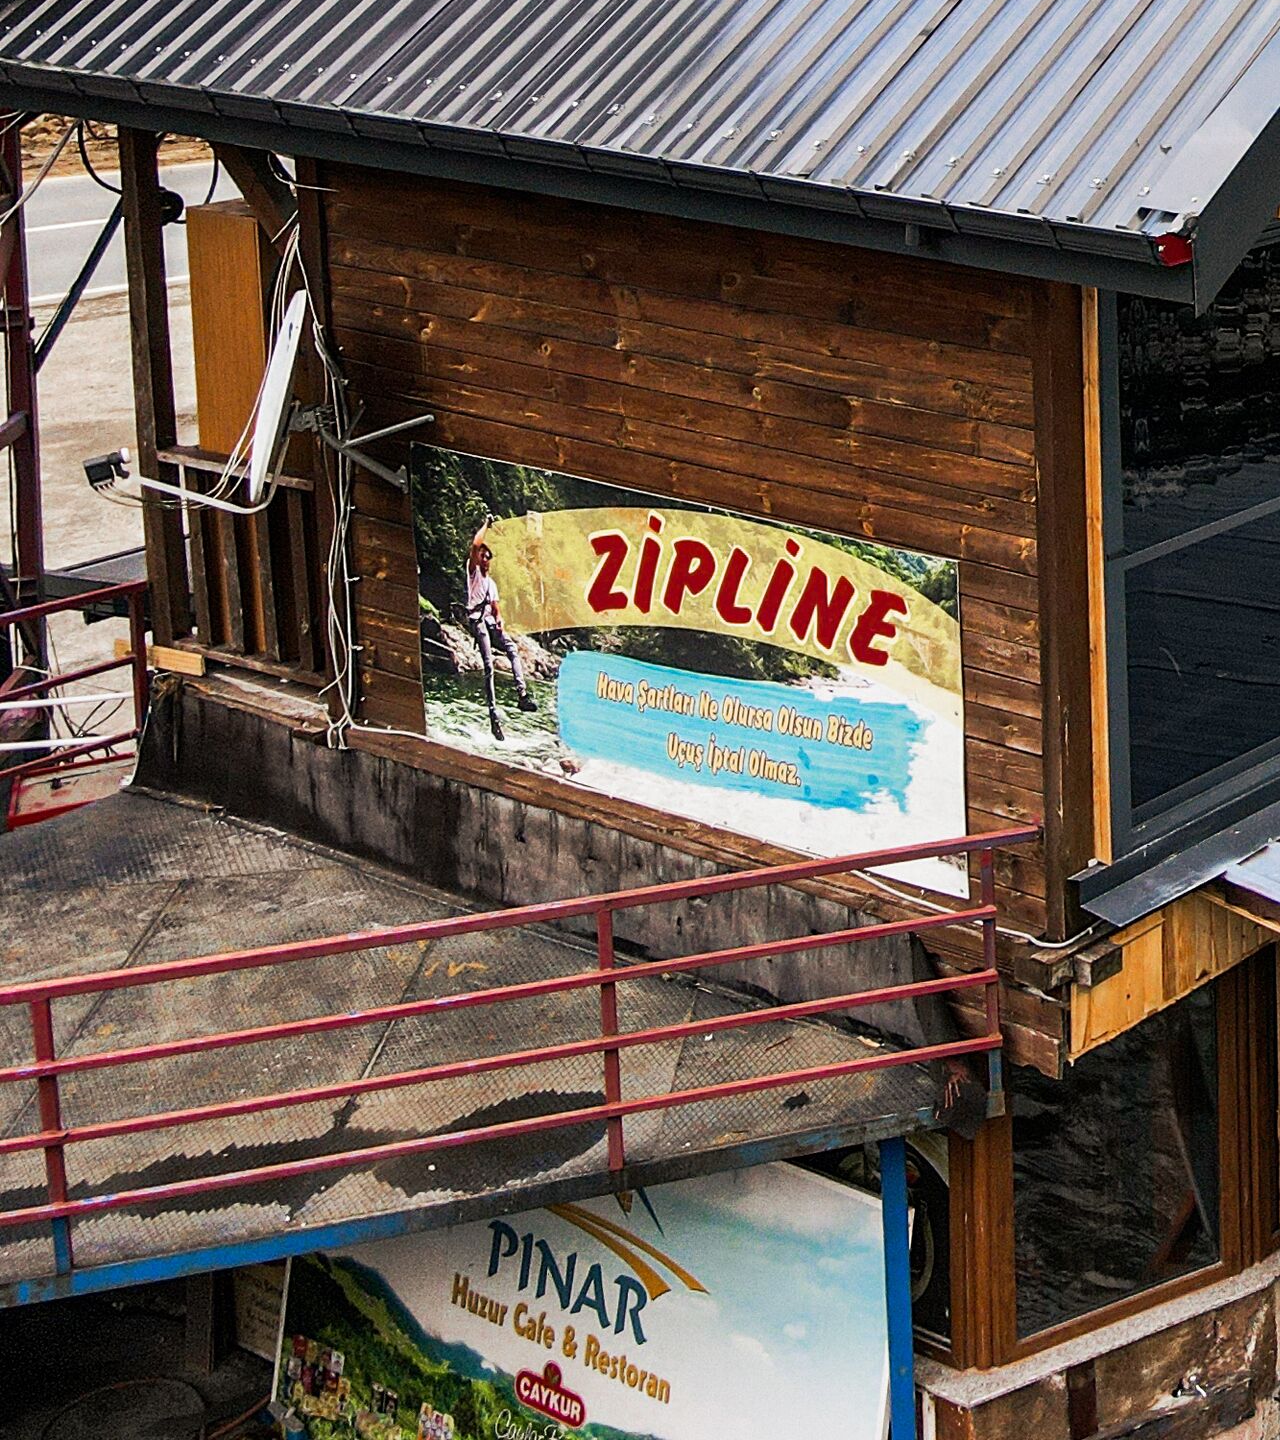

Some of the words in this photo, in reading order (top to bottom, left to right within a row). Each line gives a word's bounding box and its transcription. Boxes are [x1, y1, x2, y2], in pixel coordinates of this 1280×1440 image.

[597, 671, 635, 705] Hava
[638, 679, 695, 713] Şartları
[699, 690, 719, 721] Ne
[723, 695, 773, 732] Olursa
[777, 704, 823, 741] Olsun
[827, 714, 873, 751] Bizde
[667, 732, 704, 772] Uçuş
[707, 733, 746, 775] İptal
[748, 748, 802, 787] Olmaz.
[487, 1218, 648, 1346] PINAR
[451, 1272, 509, 1327] Huzur
[512, 1302, 555, 1349] Cafe
[562, 1325, 578, 1359] &
[584, 1334, 671, 1404] Restoran
